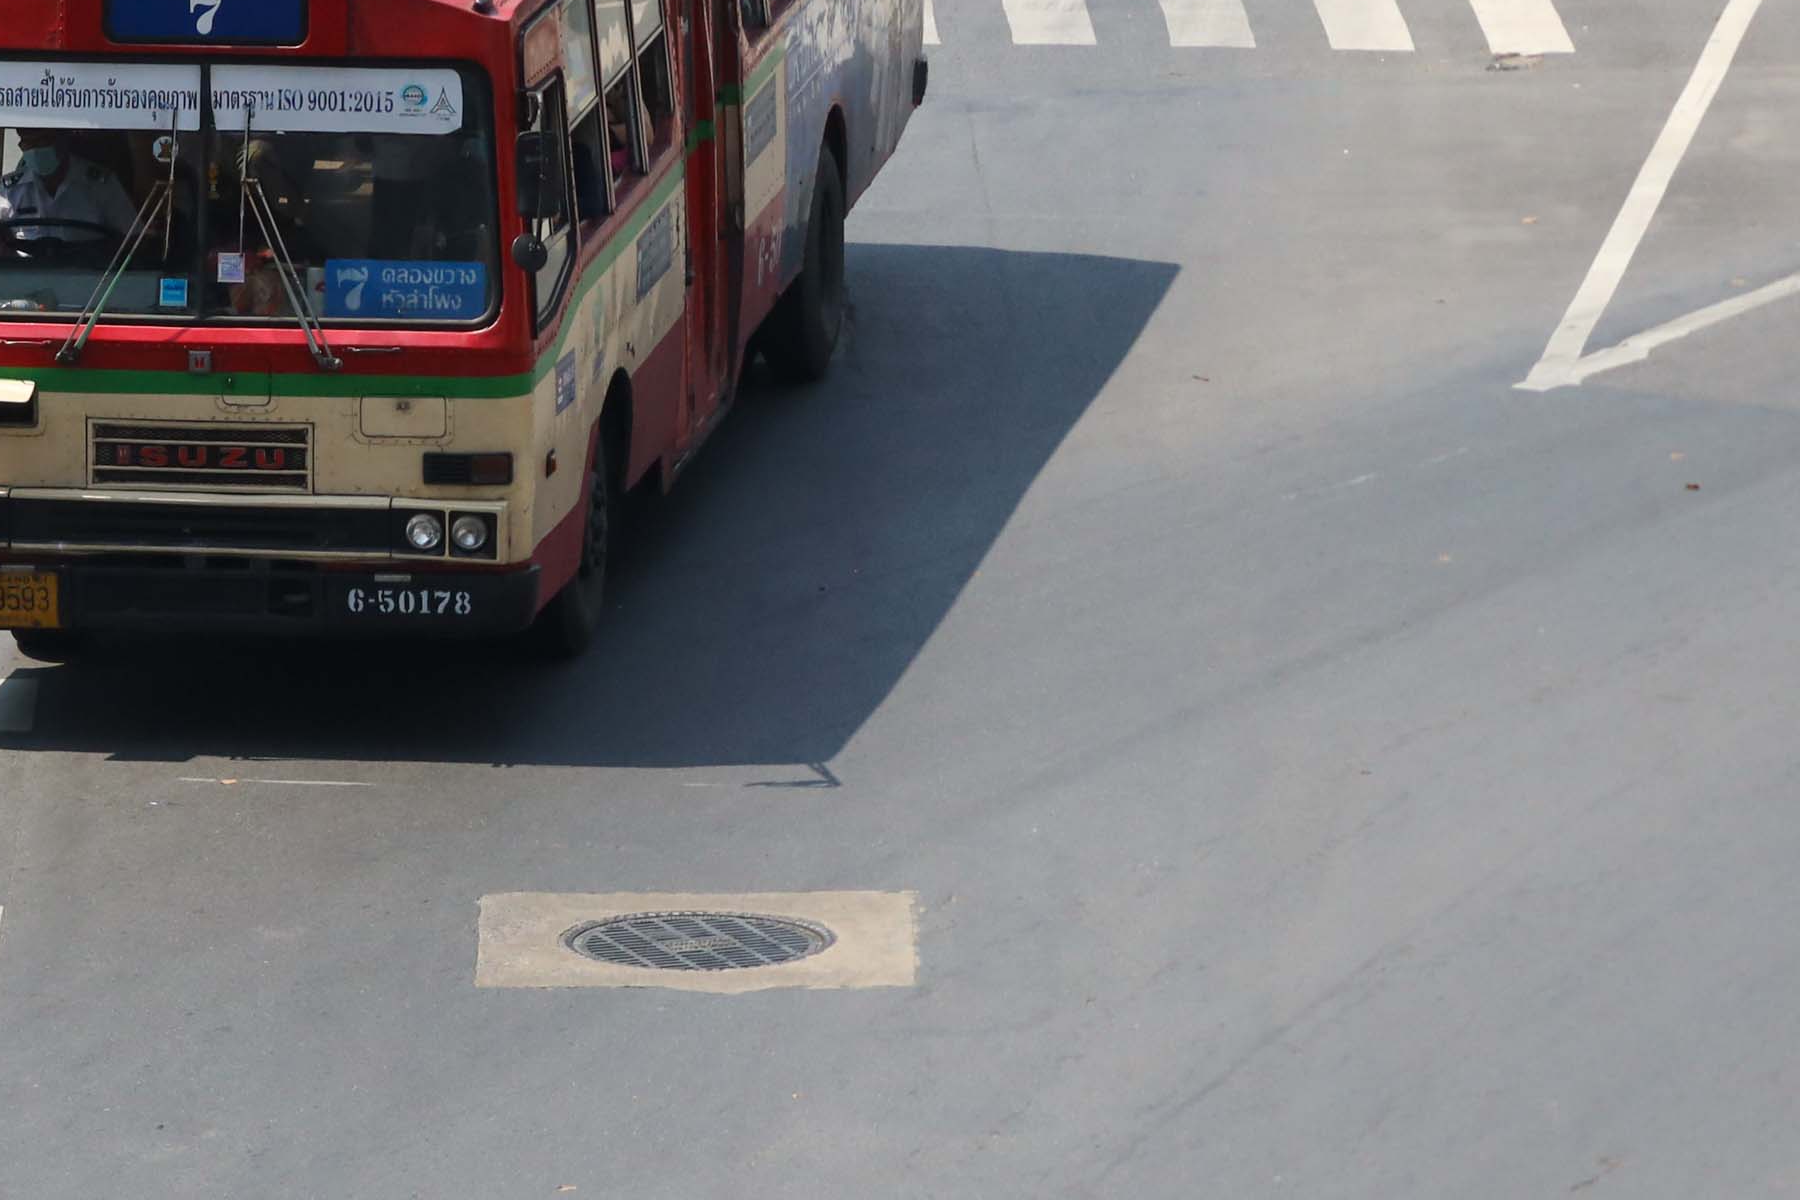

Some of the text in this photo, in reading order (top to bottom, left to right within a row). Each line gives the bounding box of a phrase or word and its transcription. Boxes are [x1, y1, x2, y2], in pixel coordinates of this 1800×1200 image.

[277, 87, 304, 112] ISO
[307, 88, 395, 114] 9001:2015
[336, 266, 368, 312] 7
[116, 444, 286, 470] ISUZU
[347, 587, 472, 615] 6-50178
